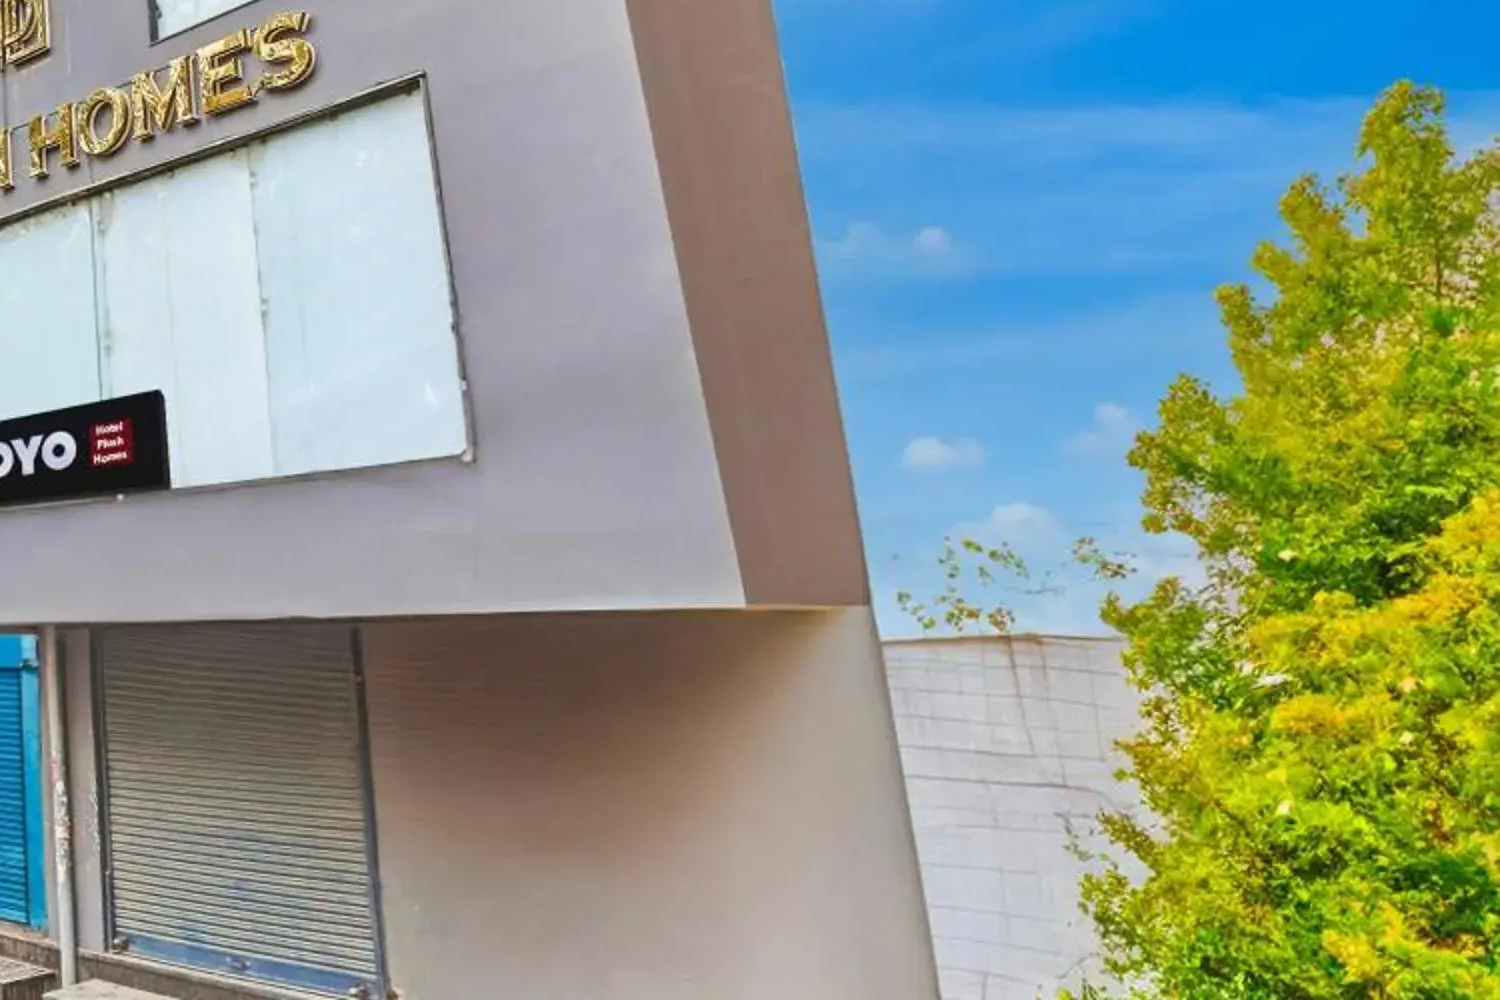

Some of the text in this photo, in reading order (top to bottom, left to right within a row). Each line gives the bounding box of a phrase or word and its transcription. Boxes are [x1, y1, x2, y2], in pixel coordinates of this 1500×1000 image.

[28, 9, 318, 178] HOMES
[94, 420, 124, 436] Hotel
[96, 436, 125, 450] Plush
[92, 451, 128, 466] Homes
